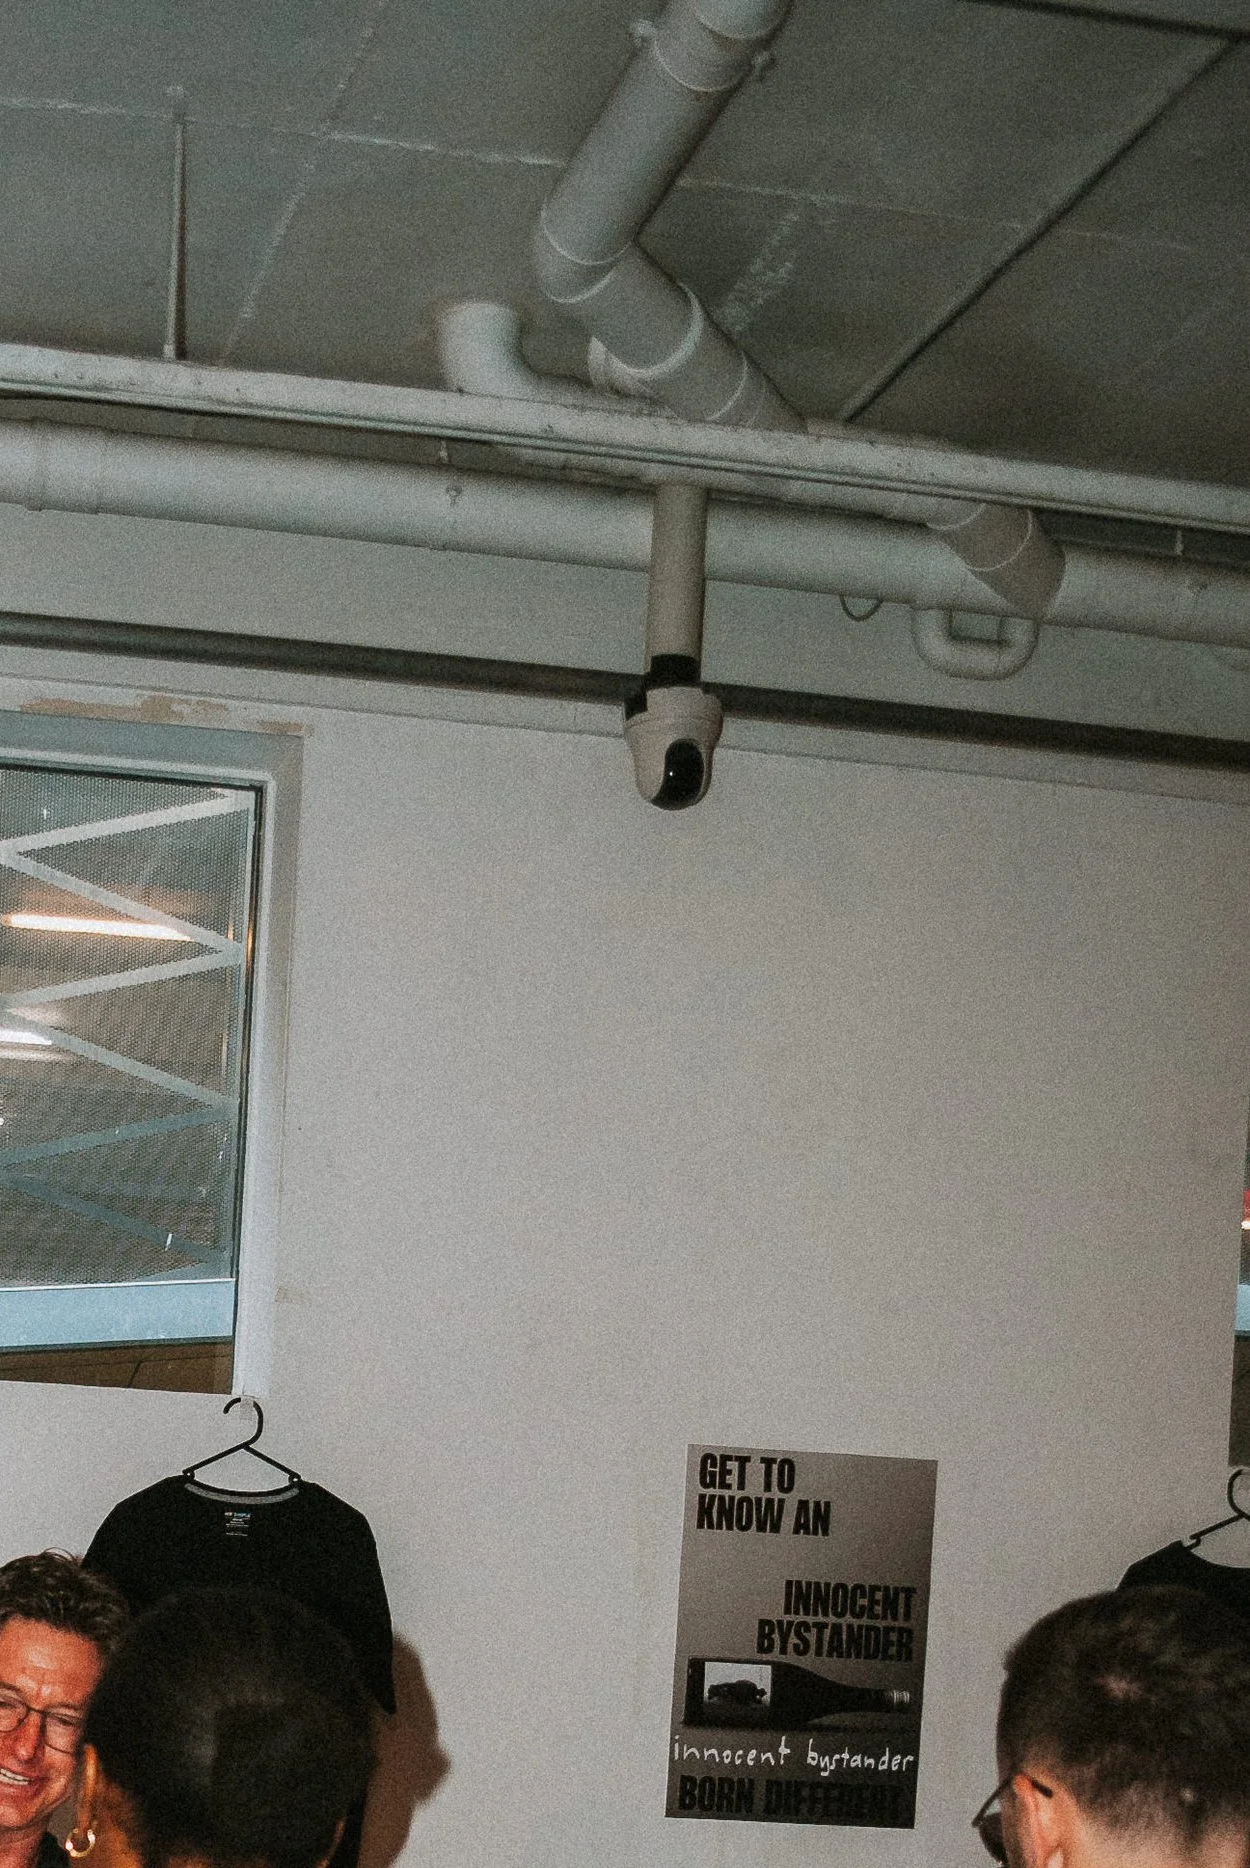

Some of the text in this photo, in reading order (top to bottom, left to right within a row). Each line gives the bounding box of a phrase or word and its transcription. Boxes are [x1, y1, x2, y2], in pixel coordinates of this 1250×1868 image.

[698, 1452, 797, 1494] GET TO
[696, 1493, 832, 1537] KNOW AN
[783, 1579, 918, 1622] INNOCENT
[756, 1618, 915, 1662] BYSTANDER
[673, 1734, 916, 1777] innocent bystander
[678, 1774, 756, 1814] BORN
